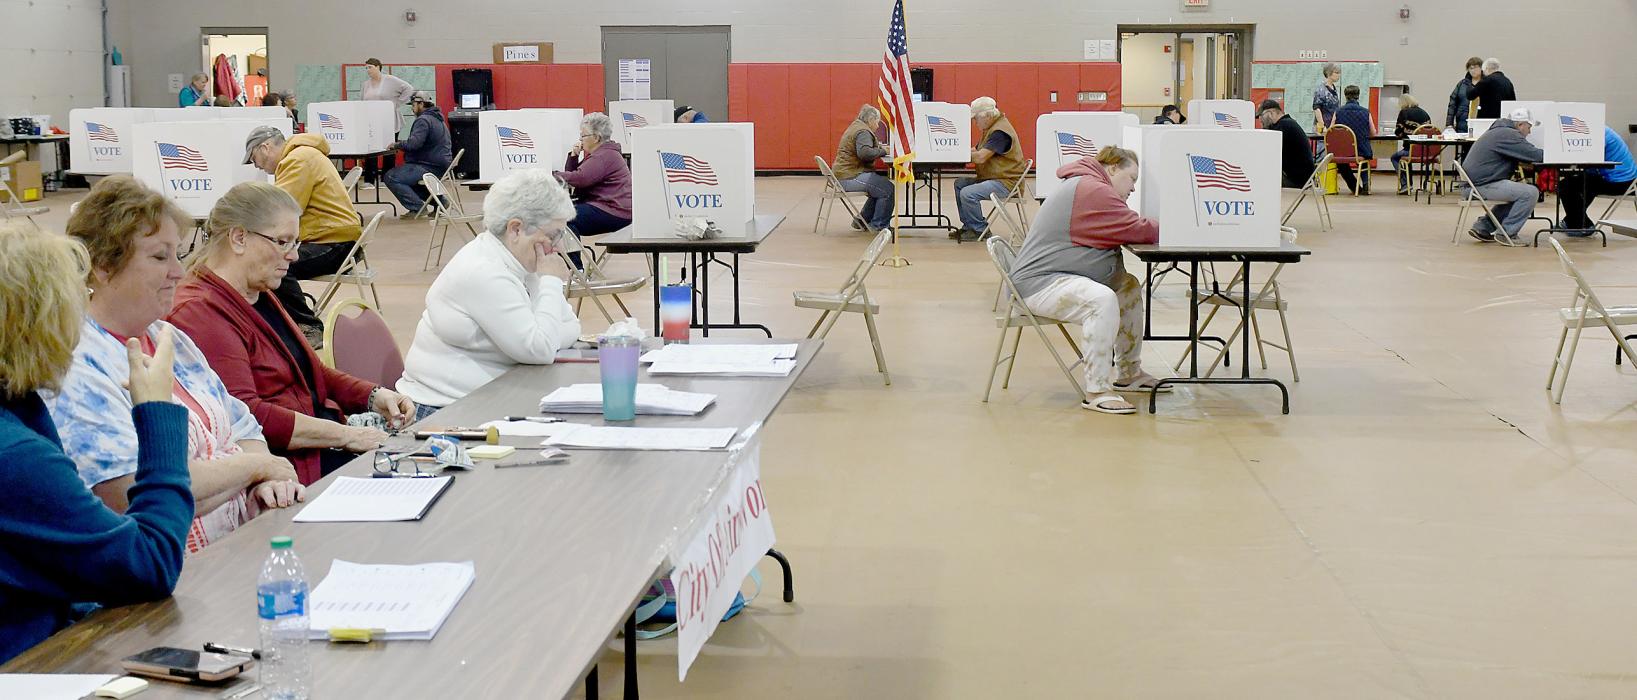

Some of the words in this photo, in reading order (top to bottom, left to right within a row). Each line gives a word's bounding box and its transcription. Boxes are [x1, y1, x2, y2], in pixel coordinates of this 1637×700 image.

[506, 50, 536, 60] Pines
[324, 132, 345, 140] VOTE
[934, 138, 960, 147] VOTE
[1566, 138, 1593, 147] VOTE
[94, 146, 121, 156] VOTE
[506, 153, 537, 164] VOTE
[170, 178, 212, 191] VOTE
[674, 194, 723, 209] VOTE
[1204, 200, 1255, 216] VOTE
